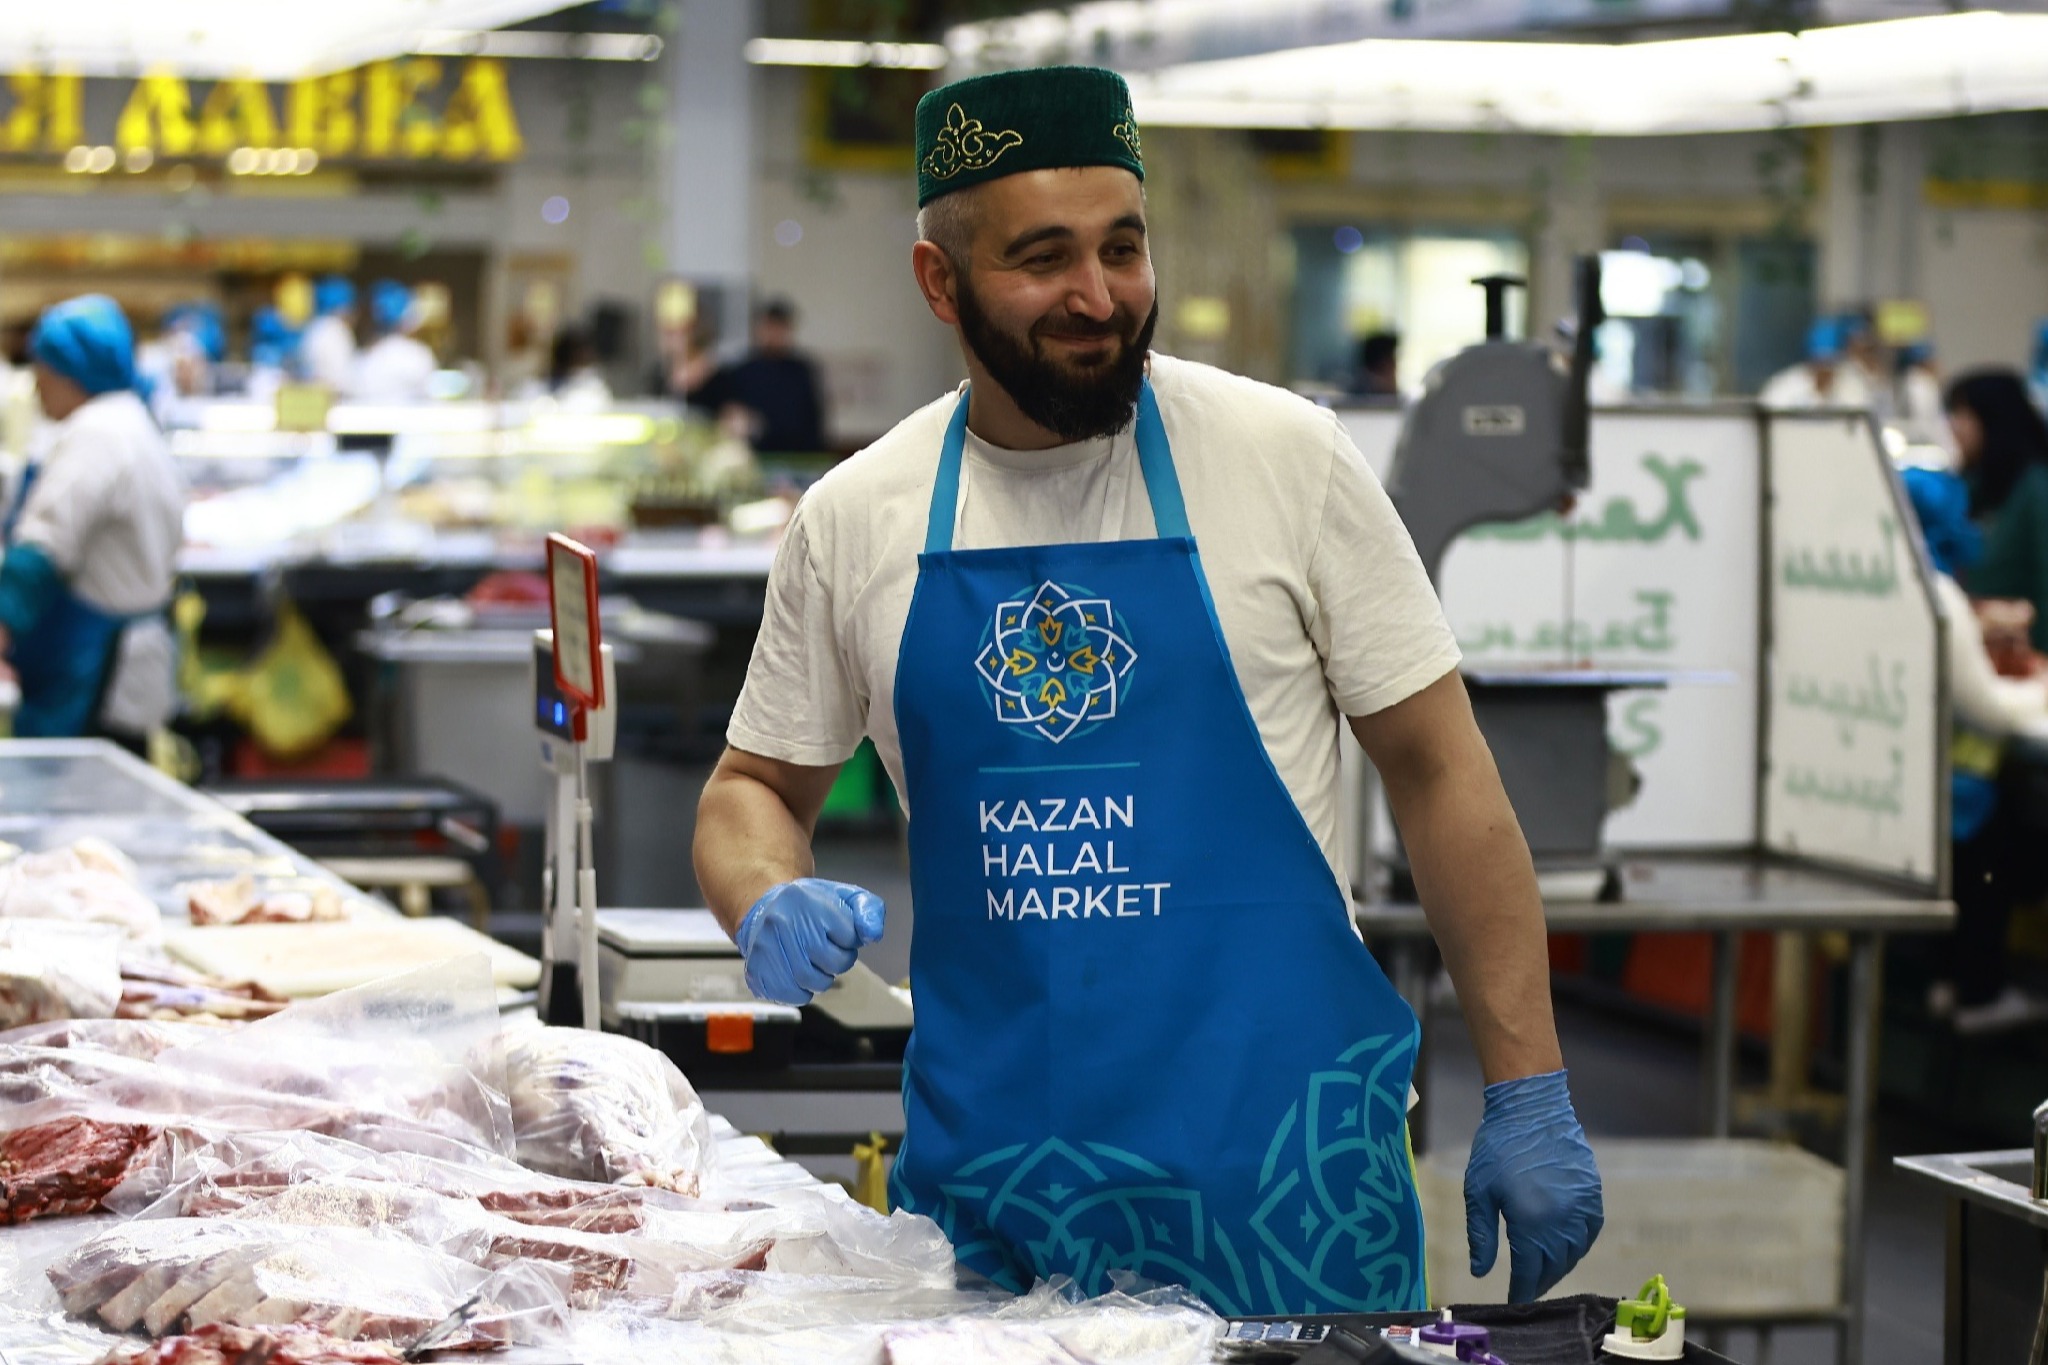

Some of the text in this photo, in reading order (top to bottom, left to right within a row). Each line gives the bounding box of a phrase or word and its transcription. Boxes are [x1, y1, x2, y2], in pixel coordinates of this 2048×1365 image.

[979, 794, 1134, 833] KAZAN
[982, 840, 1130, 877] HALAL
[986, 882, 1171, 921] MARKET
